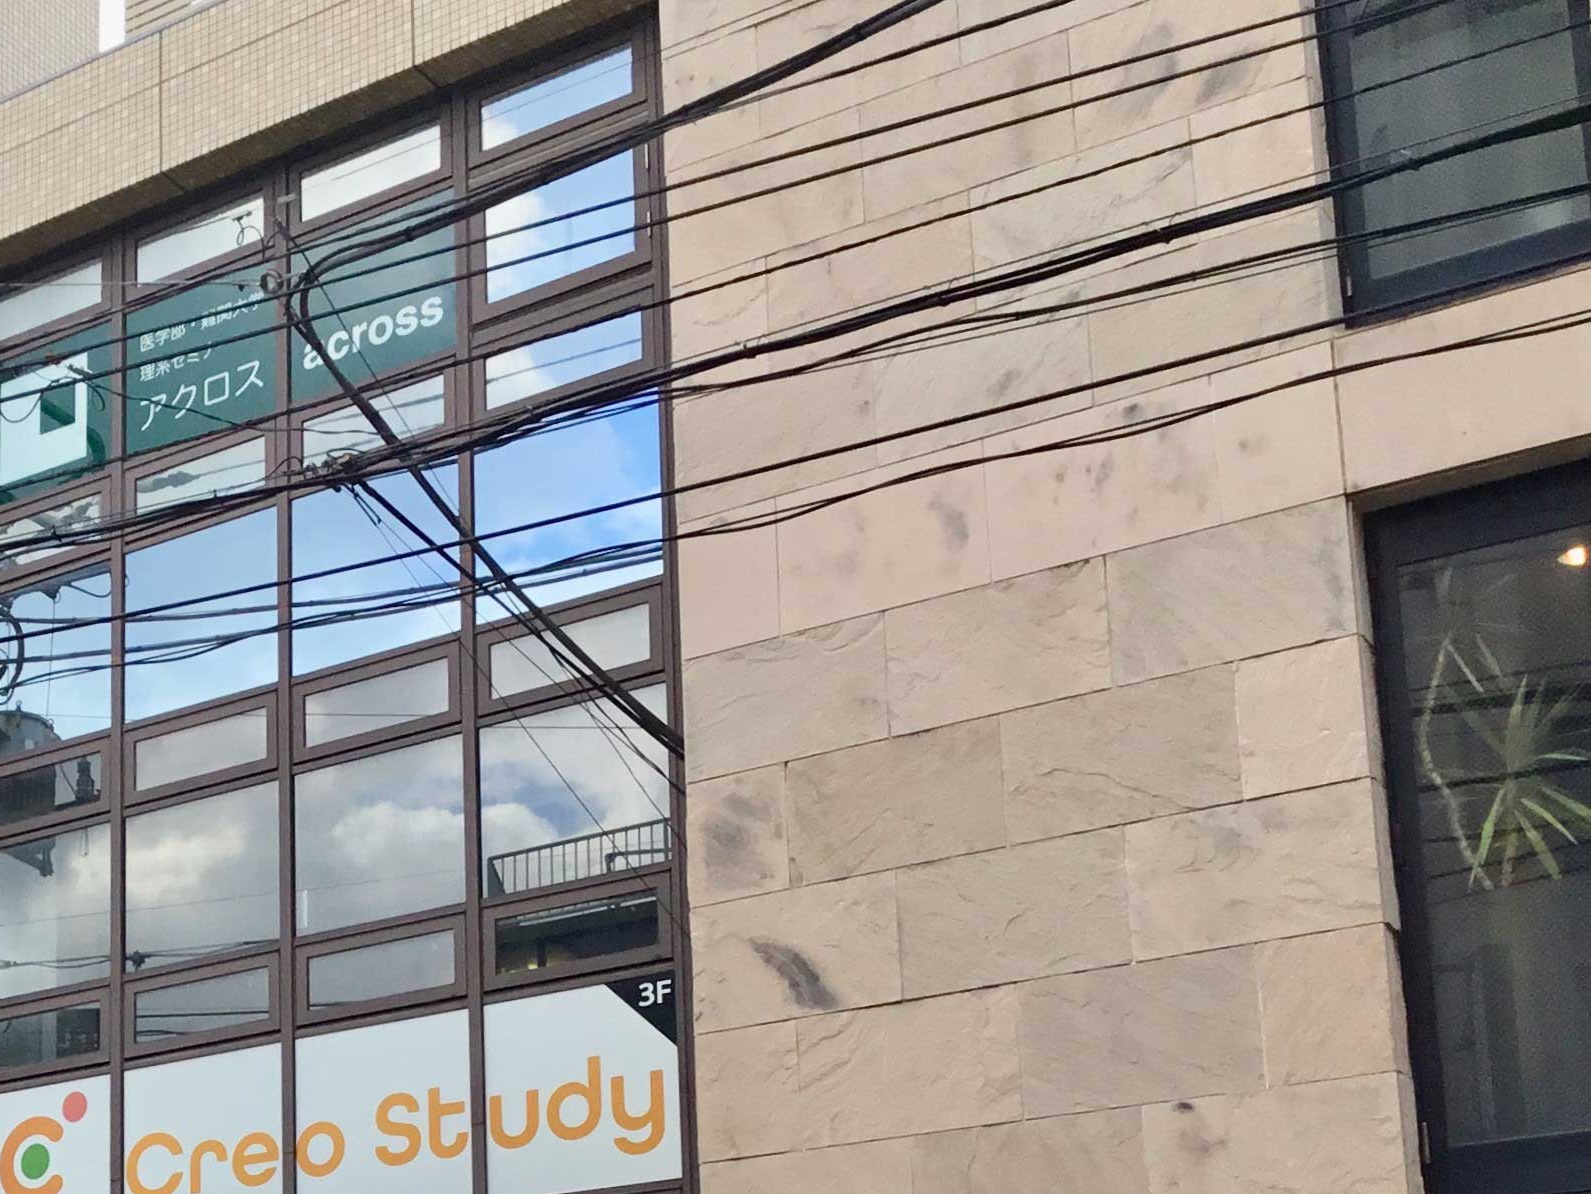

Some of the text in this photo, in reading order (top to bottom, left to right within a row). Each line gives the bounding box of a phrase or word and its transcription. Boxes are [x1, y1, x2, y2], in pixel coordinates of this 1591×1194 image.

[303, 296, 444, 369] across
[140, 360, 264, 431] アクロス
[638, 979, 672, 1008] 3F
[375, 1055, 666, 1167] Study
